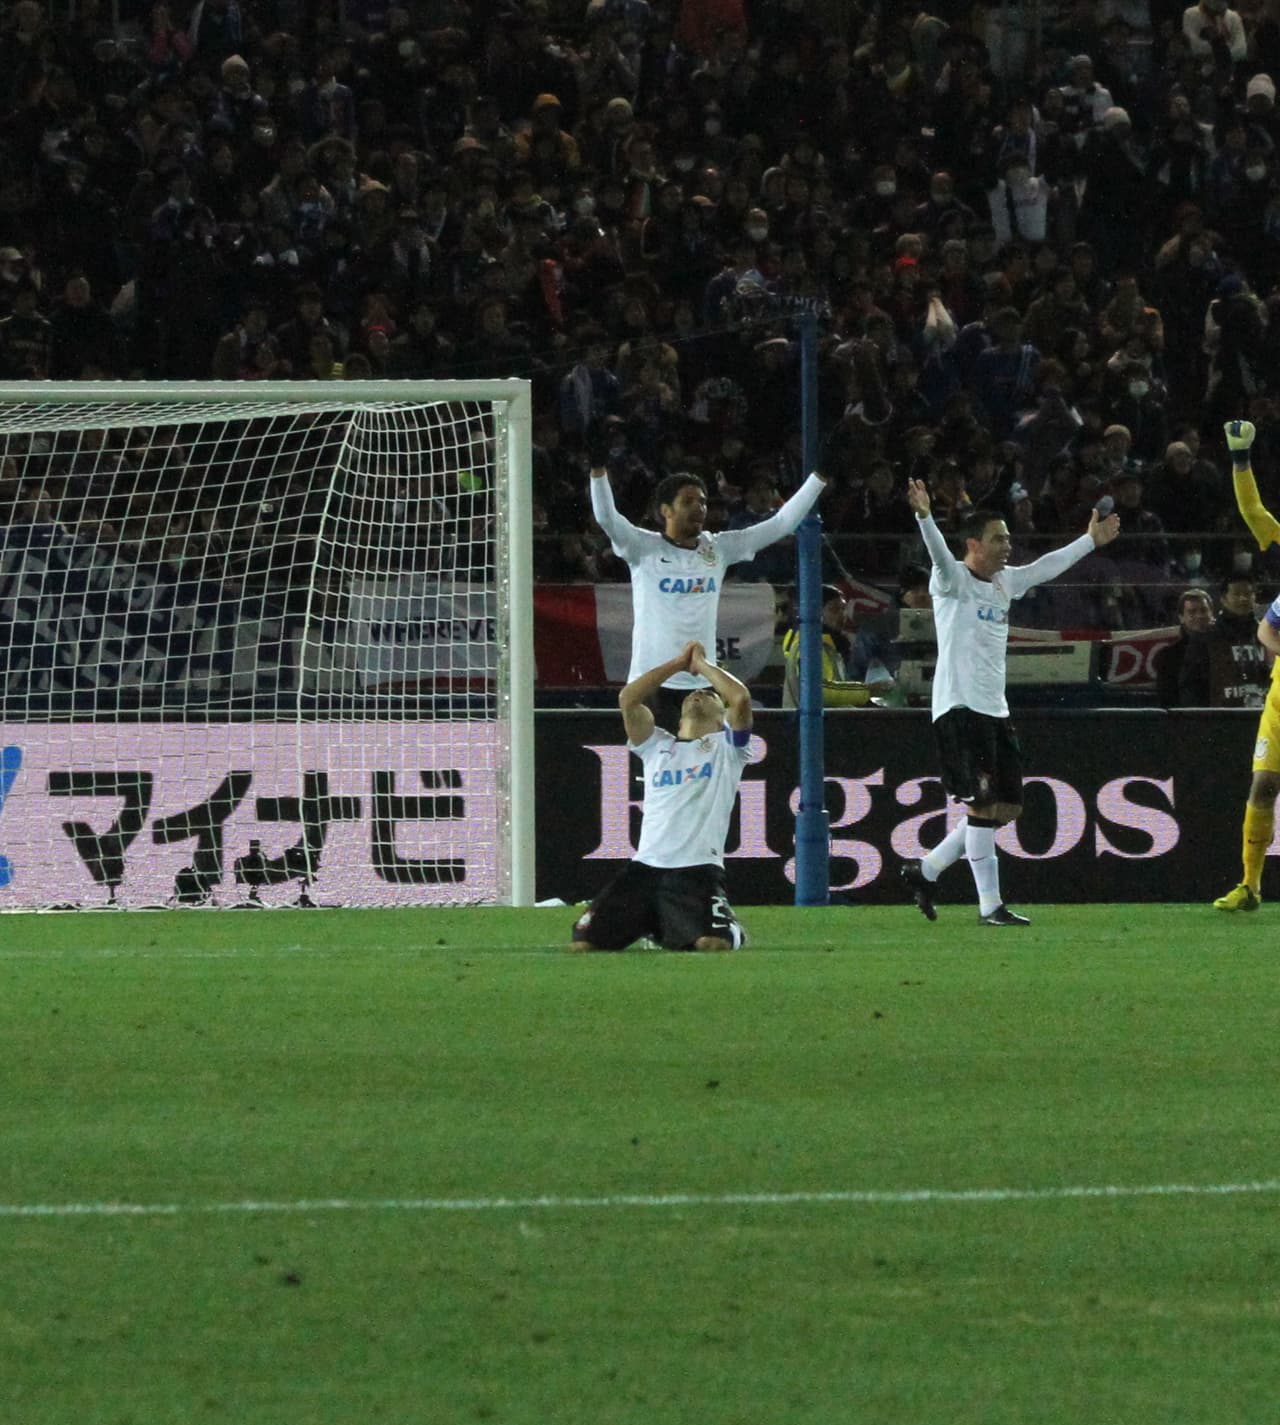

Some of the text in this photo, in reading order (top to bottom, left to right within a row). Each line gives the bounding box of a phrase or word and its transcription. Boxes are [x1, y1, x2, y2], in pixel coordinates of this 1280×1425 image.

[659, 577, 717, 593] CAIXA
[370, 618, 497, 642] WHEREVE
[652, 762, 713, 788] CAIXA
[47, 770, 466, 883] マイナビ
